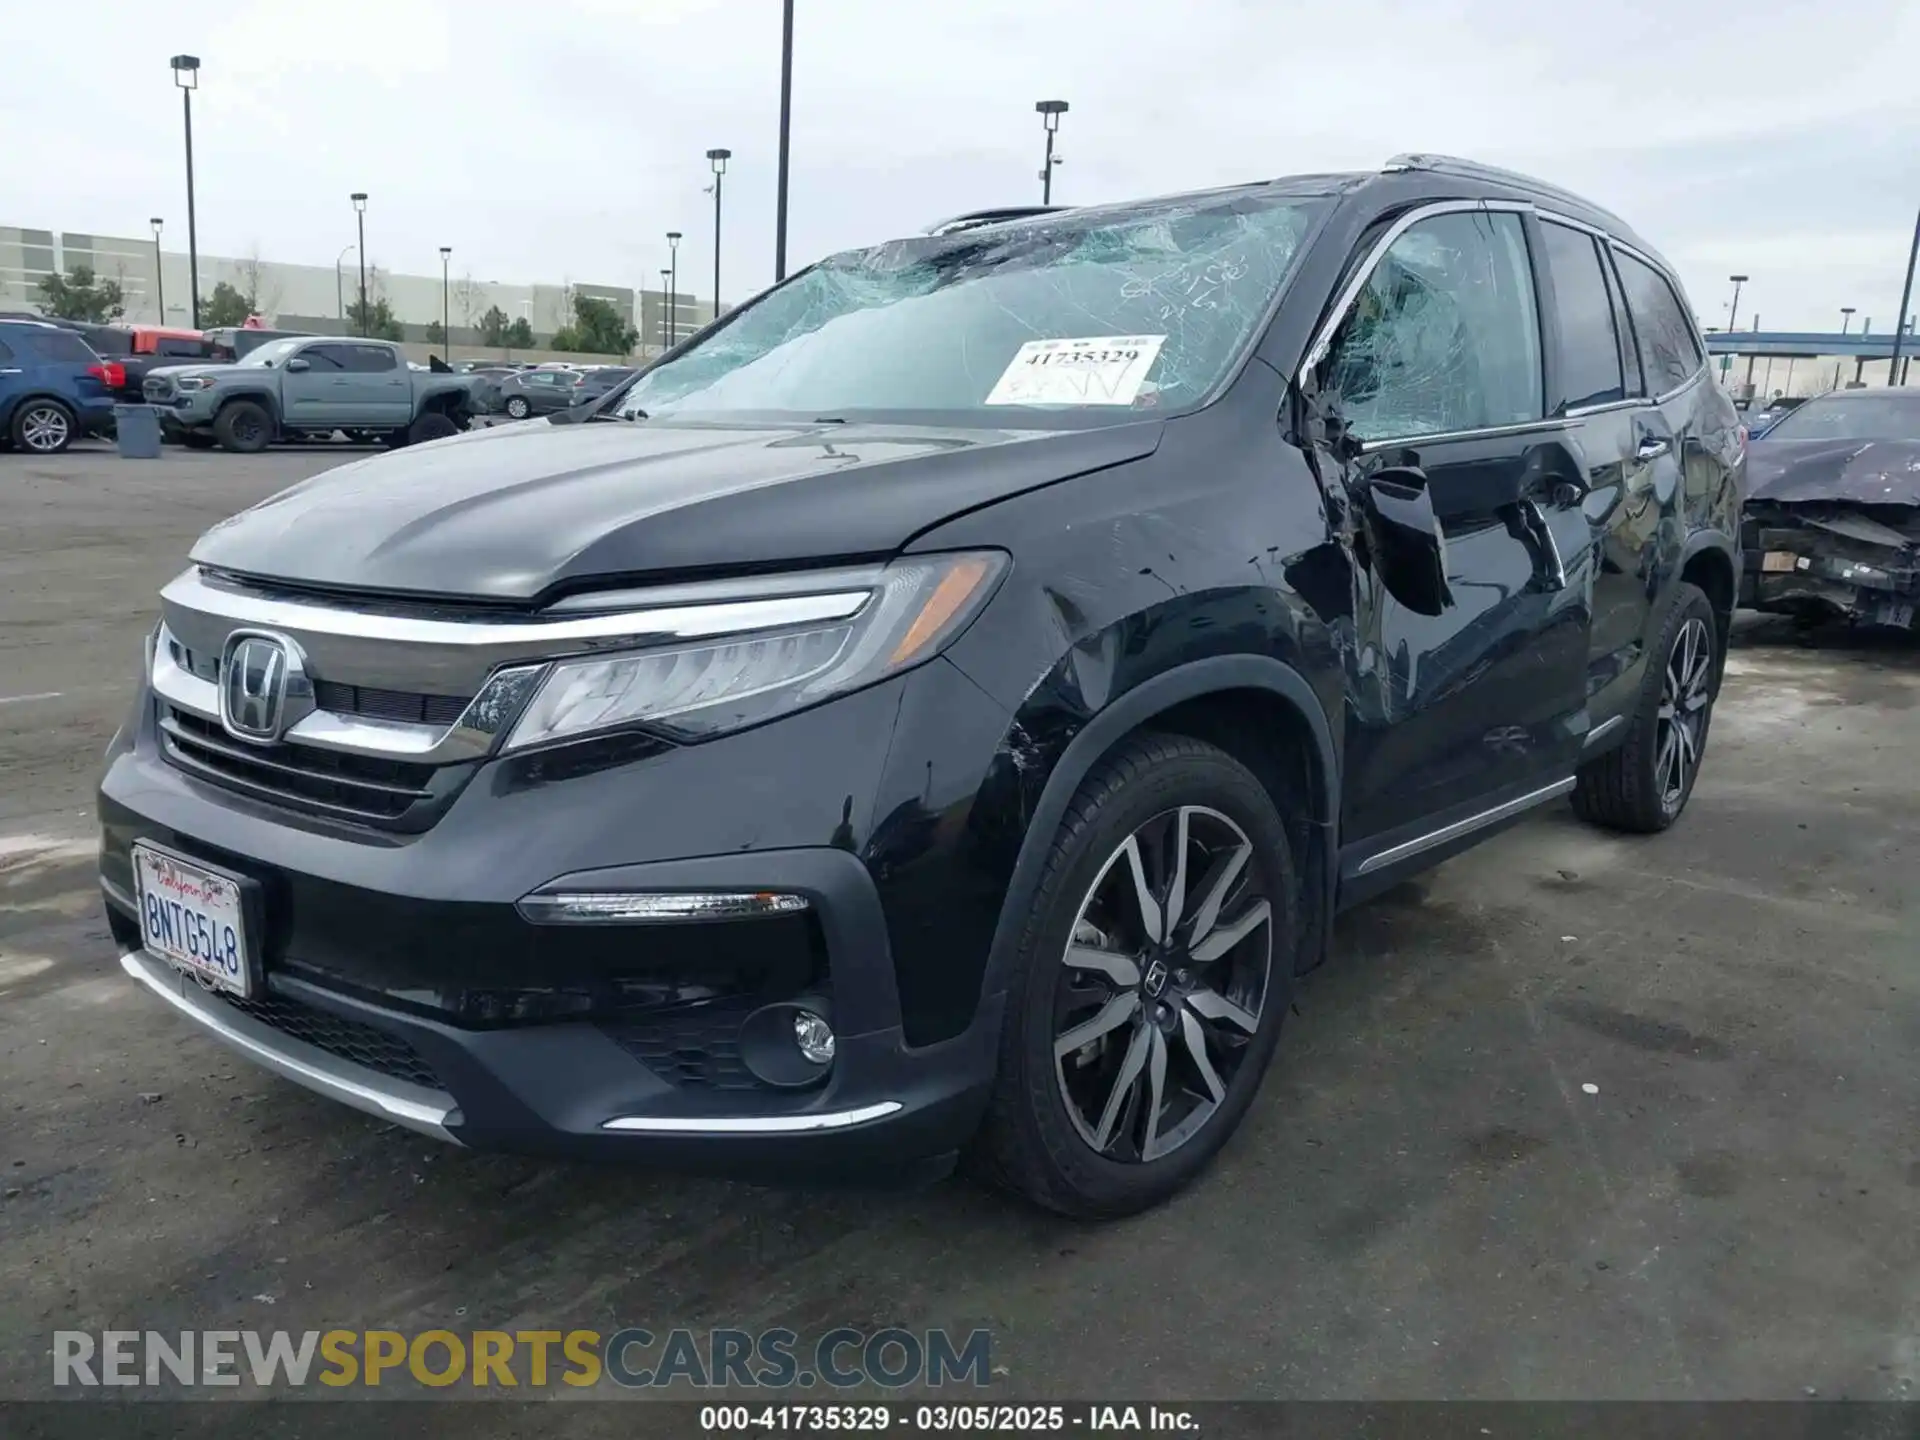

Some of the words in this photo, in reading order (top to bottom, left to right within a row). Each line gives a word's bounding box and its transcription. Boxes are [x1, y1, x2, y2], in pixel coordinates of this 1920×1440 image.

[1025, 349, 1139, 366] 41735329
[157, 870, 221, 908] California
[146, 892, 238, 975] 8NTG548
